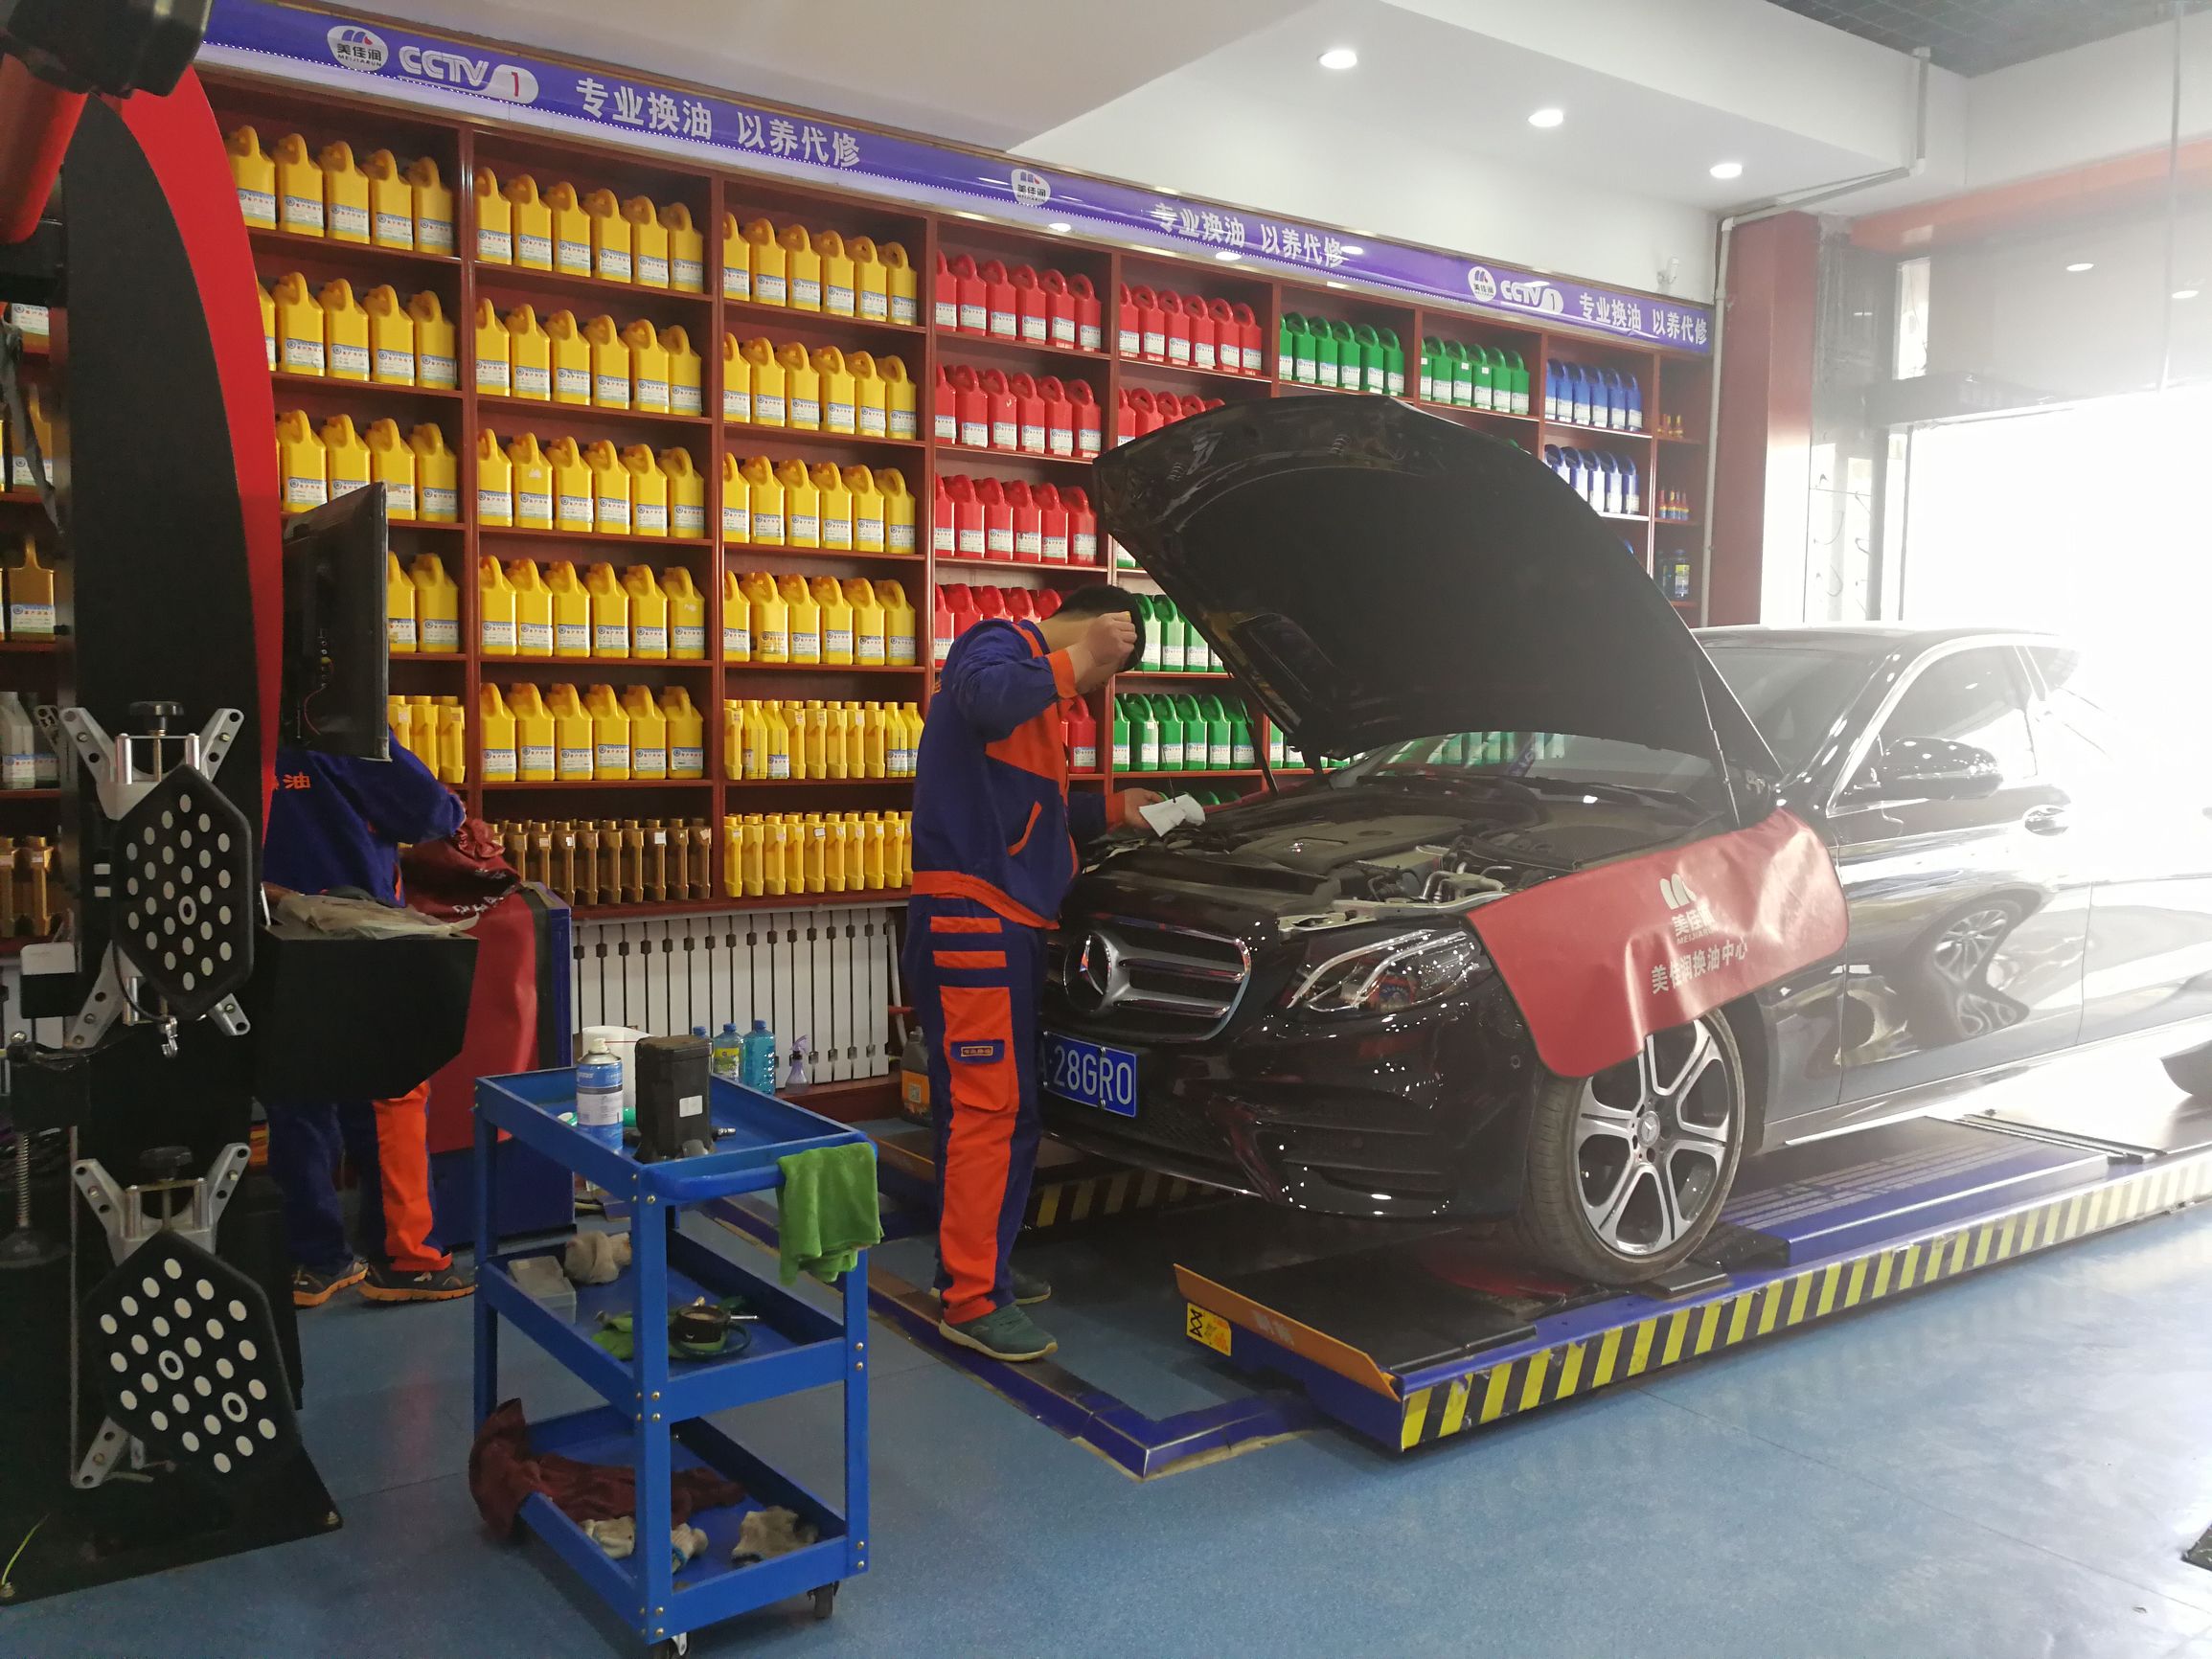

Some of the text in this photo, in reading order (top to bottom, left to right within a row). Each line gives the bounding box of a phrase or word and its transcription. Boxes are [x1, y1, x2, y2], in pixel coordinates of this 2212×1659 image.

[337, 43, 381, 61] 美佳润
[337, 55, 381, 67] MEIJIARUN
[399, 46, 489, 86] CCTV
[576, 77, 860, 168] 专业换油 以养代修
[1151, 202, 1345, 268] 专业换油 以养代修
[1579, 292, 1707, 346] 专业换油 以养代修
[275, 771, 311, 790] 油
